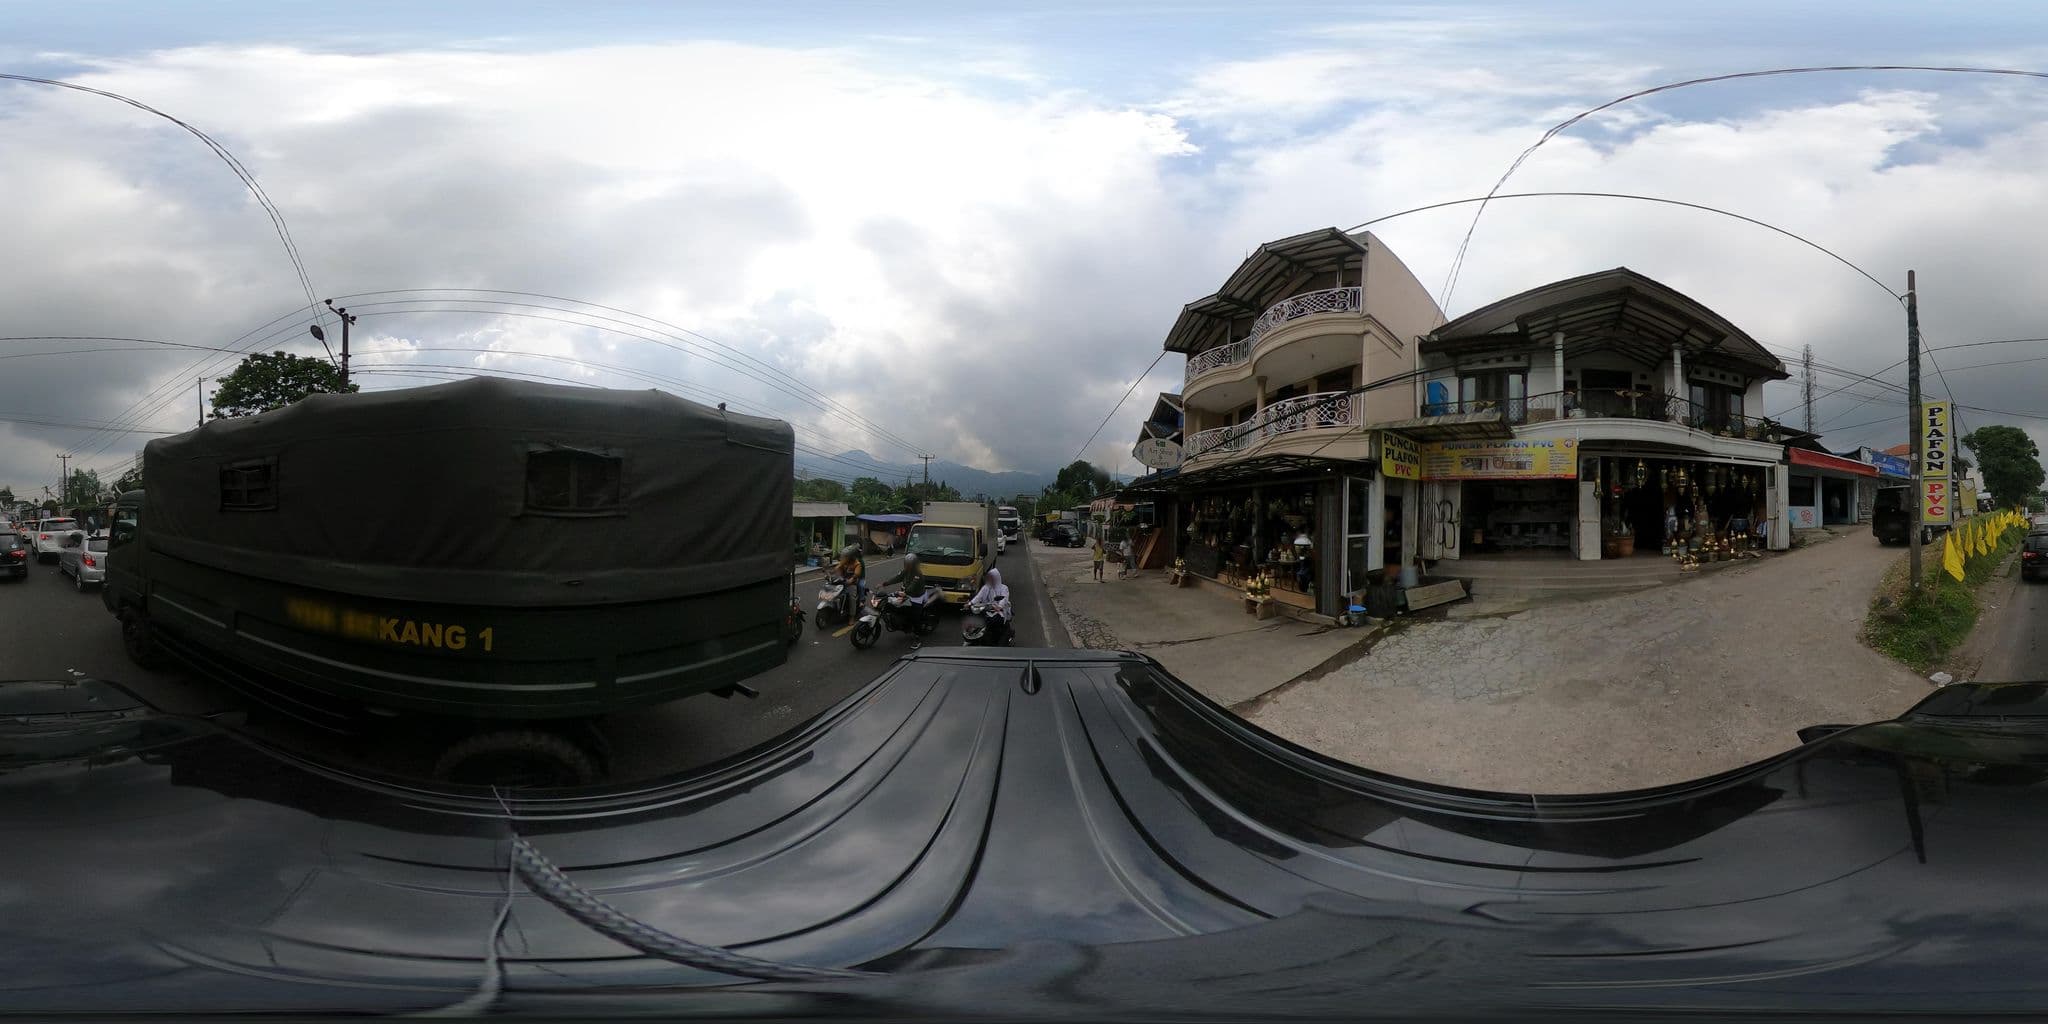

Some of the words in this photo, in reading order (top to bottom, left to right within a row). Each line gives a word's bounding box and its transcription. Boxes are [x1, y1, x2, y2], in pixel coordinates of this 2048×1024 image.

[1384, 433, 1419, 453] PUNCAK
[1442, 440, 1483, 450] PUNCAK
[1486, 440, 1529, 449] PLAFON
[1532, 440, 1555, 448] PVC
[1927, 407, 1945, 472] PLAFON
[1385, 447, 1419, 465] PLAFON
[1394, 463, 1411, 476] PVC
[1927, 483, 1945, 517] PVC
[342, 609, 466, 650] KANG
[479, 627, 493, 651] 1
